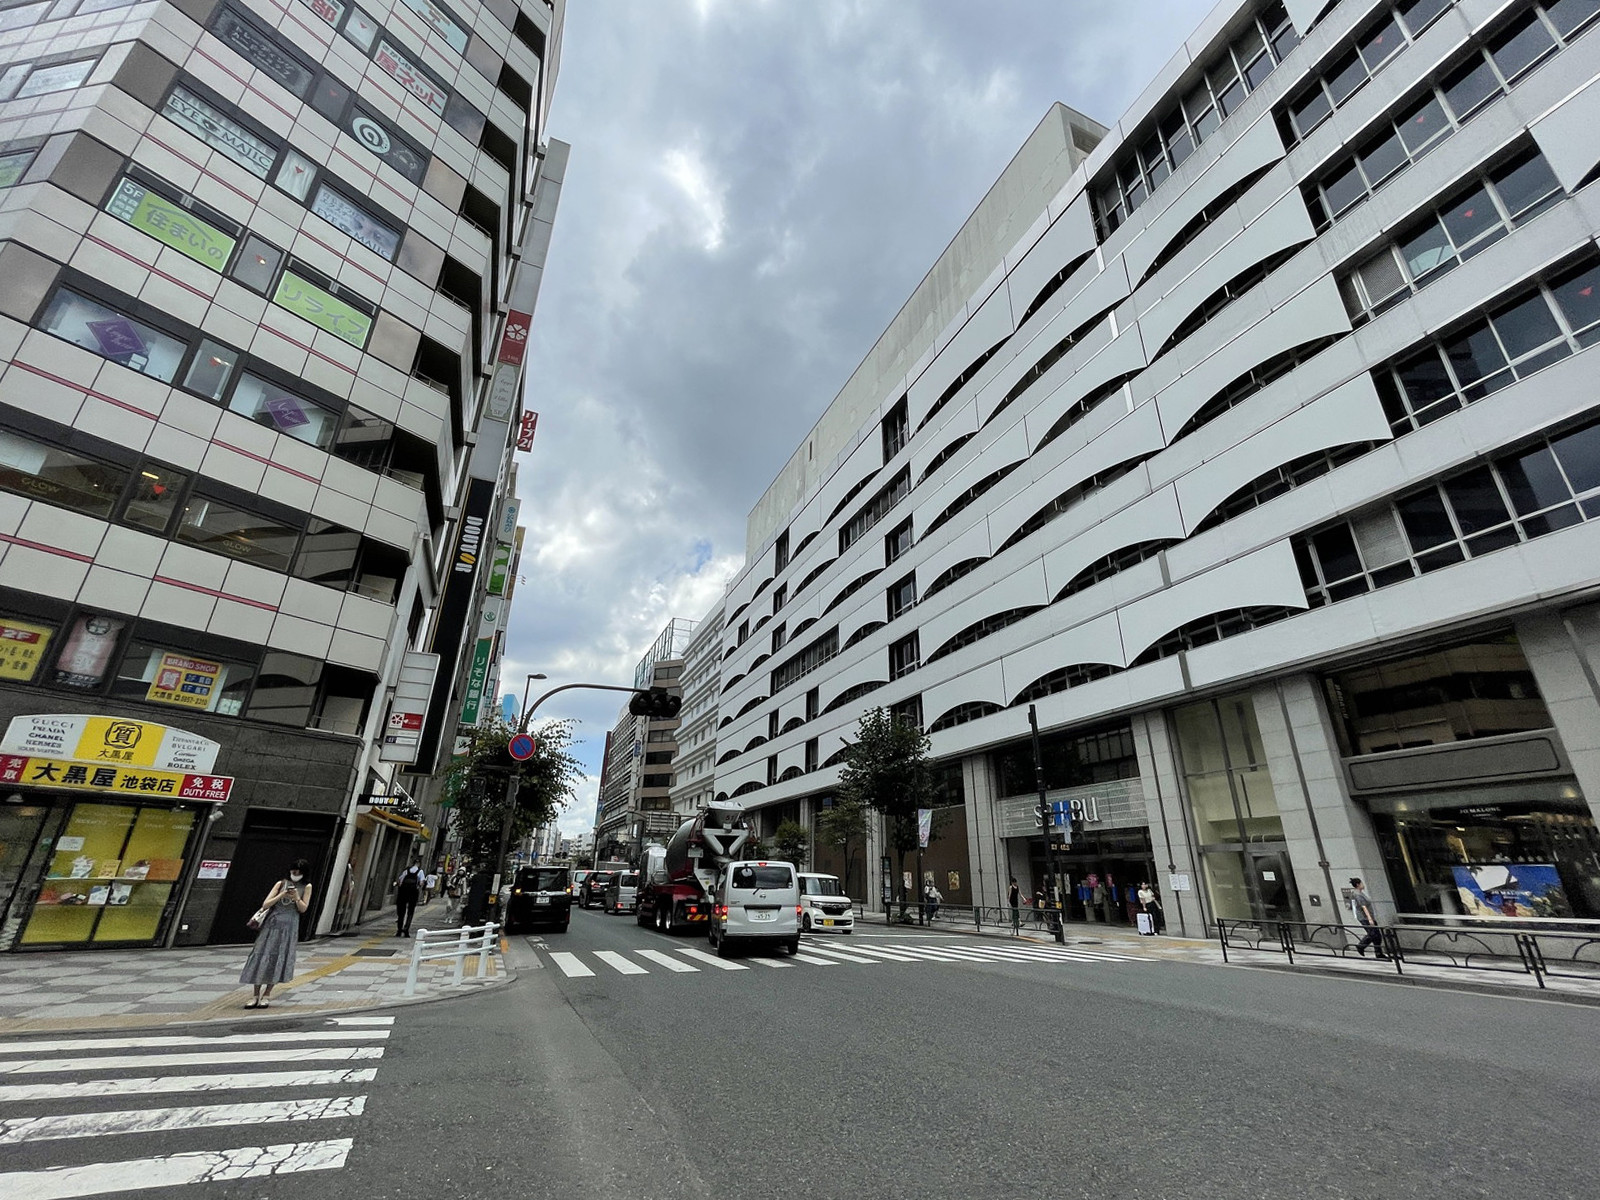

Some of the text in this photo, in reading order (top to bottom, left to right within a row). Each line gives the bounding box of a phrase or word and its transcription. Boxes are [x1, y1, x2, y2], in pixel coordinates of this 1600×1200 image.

[171, 98, 271, 168] EYE MAJIC
[123, 183, 144, 198] 5F
[146, 209, 224, 260] 住まいの
[283, 284, 365, 335] リライフ
[519, 411, 536, 448] リーブ21
[223, 540, 252, 552] GLOW
[455, 515, 483, 573] DOUTOR
[1, 629, 33, 640] 2F
[167, 657, 217, 672] BRAND SHOP
[466, 656, 486, 710] りそな銀行
[32, 718, 74, 729] GUCCI
[33, 726, 65, 735] PRADA
[29, 732, 65, 741] CHANEL
[111, 725, 135, 745] 質
[172, 743, 206, 752] BVLGARI
[98, 749, 134, 761] 大黒屋
[167, 762, 197, 770] ROLEX
[32, 763, 177, 793] 大黒屋 池袋店
[191, 777, 224, 790] 免税
[183, 788, 226, 799] DUTY FREE
